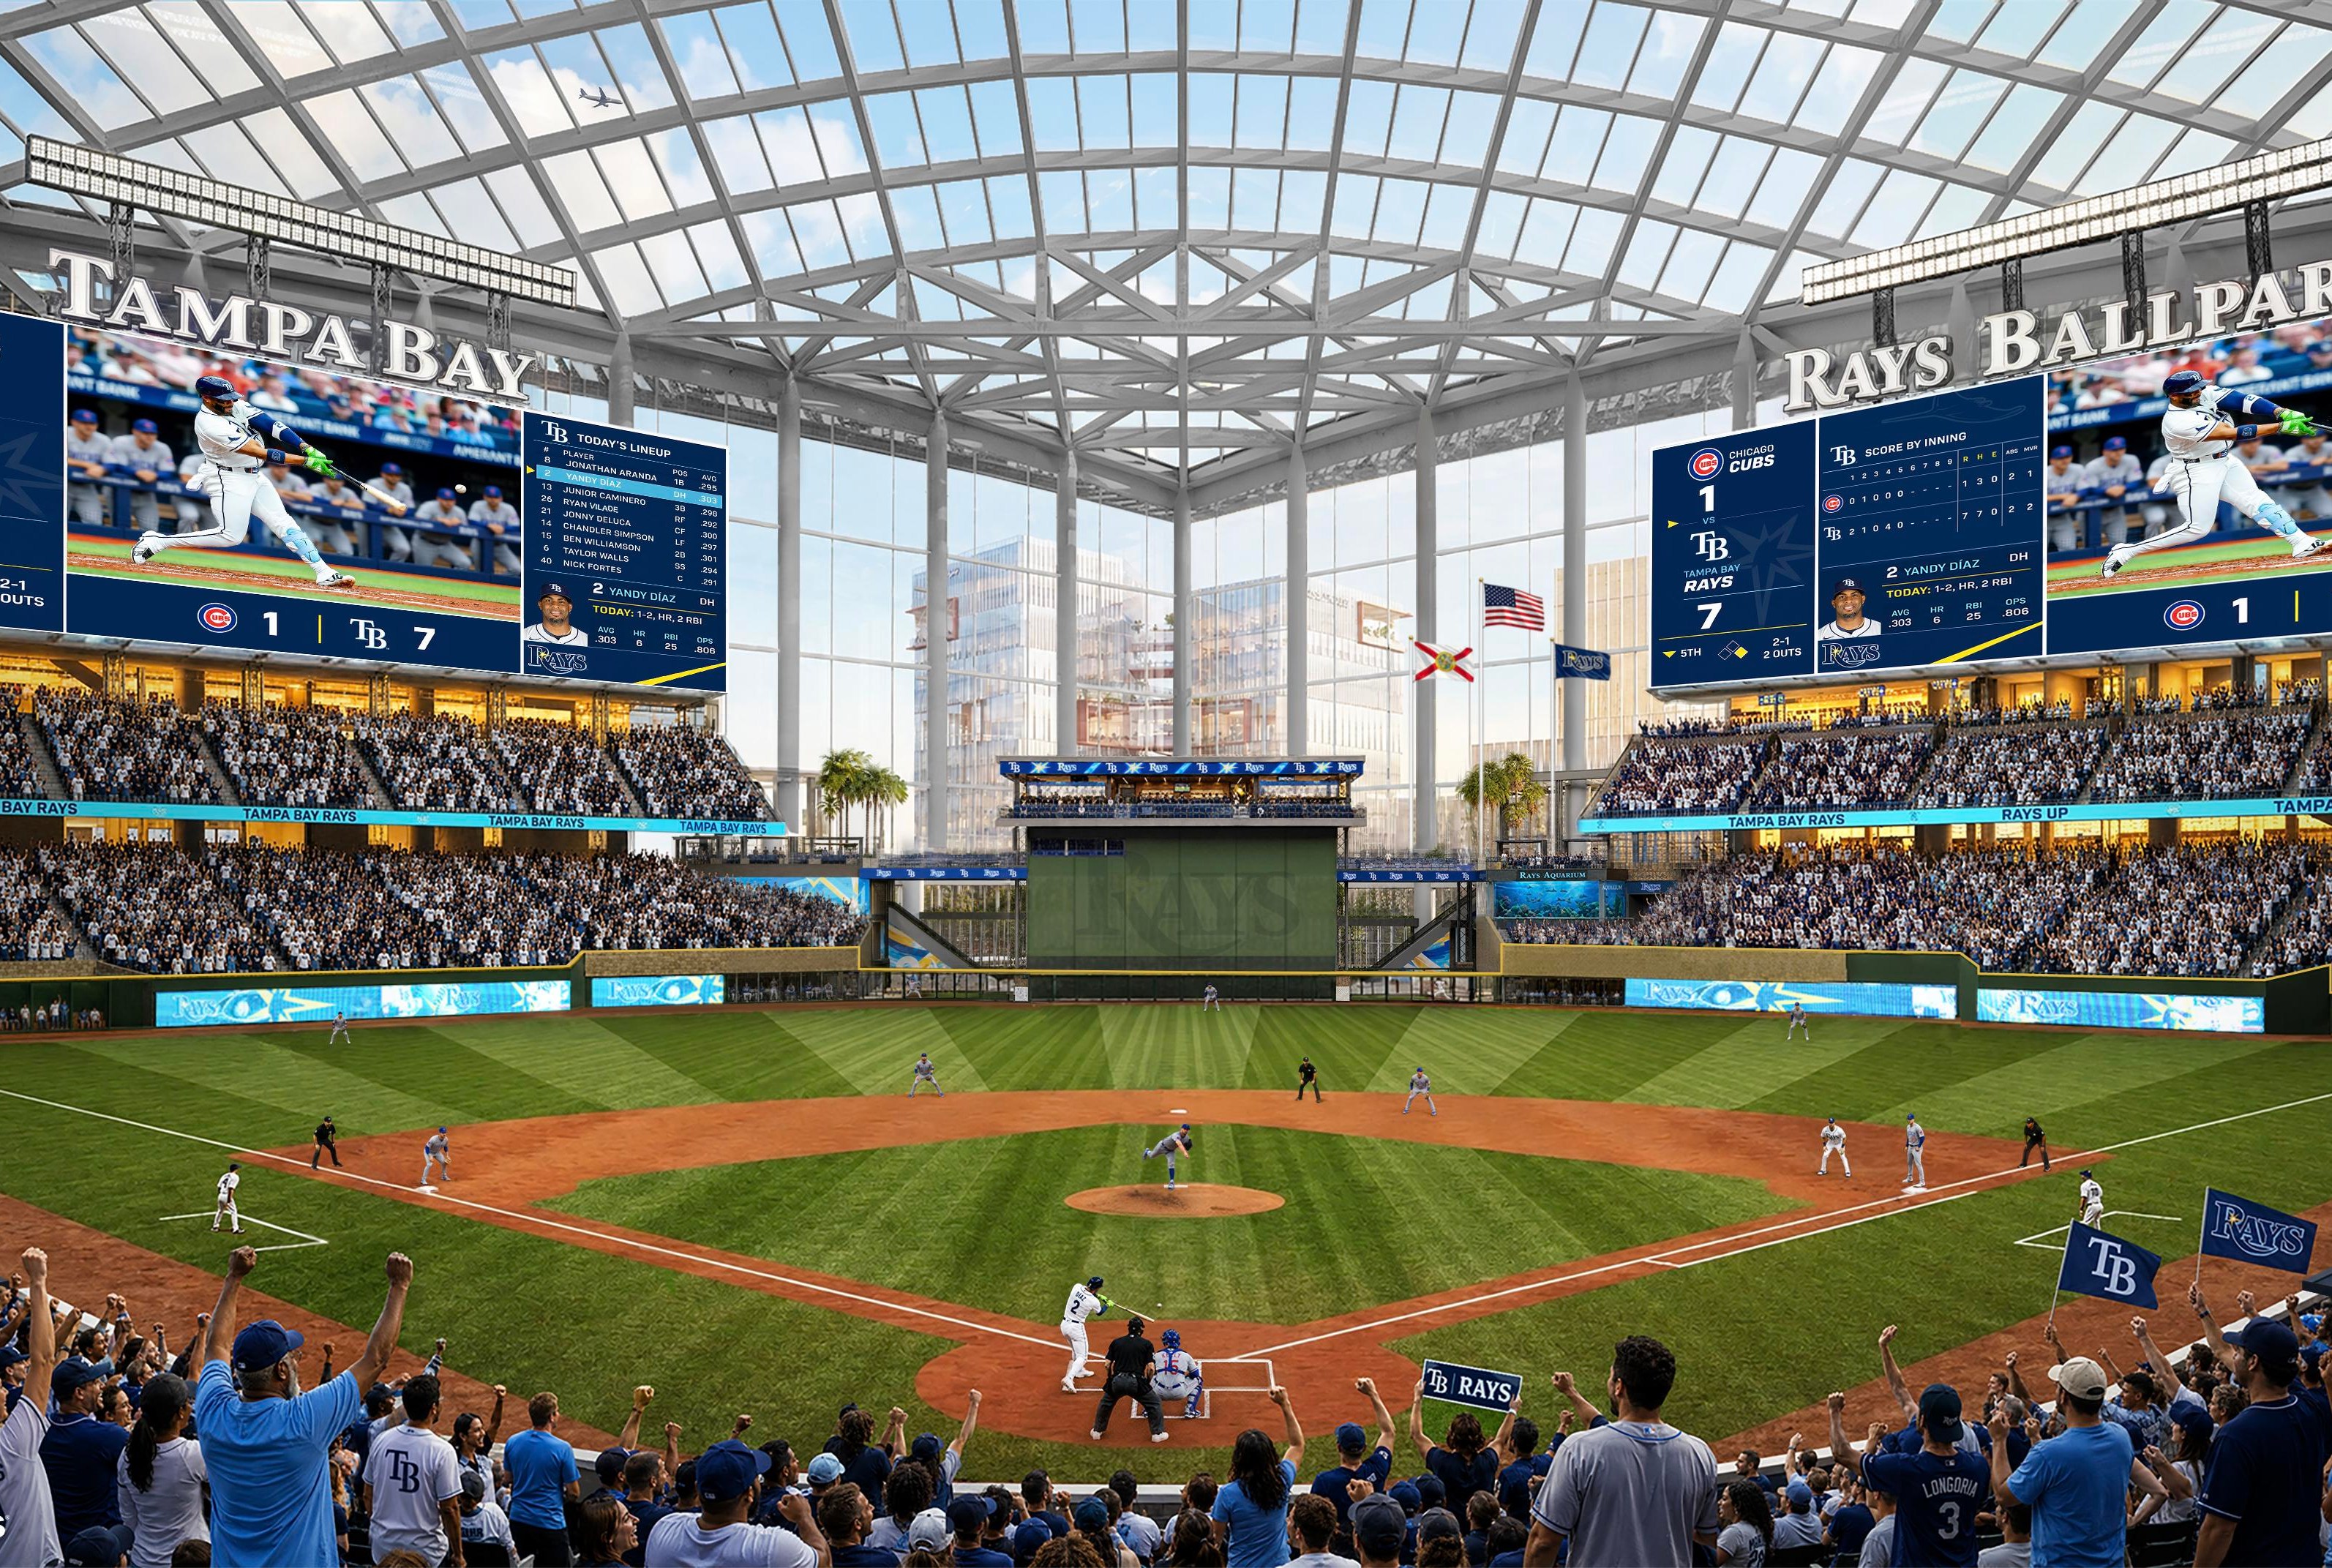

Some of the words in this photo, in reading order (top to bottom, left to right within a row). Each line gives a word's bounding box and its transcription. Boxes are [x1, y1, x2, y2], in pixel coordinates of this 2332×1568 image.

[49, 247, 367, 367] TAMPA
[383, 320, 534, 400] BAY
[1783, 336, 1954, 413] RAYS
[1984, 259, 2332, 376] BALLPAR
[541, 420, 568, 443] TB
[631, 443, 670, 457] LINEUP
[563, 450, 594, 460] PLAYER
[1730, 445, 1774, 459] CHICAGO
[1831, 446, 1856, 465] TB
[1865, 443, 1902, 457] SCORE
[1907, 440, 1922, 450] BY
[1924, 432, 1967, 447] INNING
[1730, 454, 1774, 473] CUBS
[566, 460, 617, 475] JONATHAN
[620, 470, 657, 481] ARANDA
[699, 484, 717, 492] .295
[563, 487, 597, 498] JUNIOR
[600, 492, 645, 506] CAMINERO
[566, 473, 597, 484] YANDY
[600, 479, 621, 488] DÍAZ
[698, 495, 717, 504] .303
[1699, 485, 1714, 511] 1
[563, 498, 587, 509] RYAN
[590, 503, 618, 513] VILADE
[700, 520, 717, 528] .292
[563, 510, 593, 521] JONNY
[596, 515, 631, 527] DELUCA
[1703, 517, 1715, 525] VS
[563, 522, 612, 536] CHANDLER
[615, 530, 654, 541] SIMPSON
[700, 543, 717, 551] .297
[563, 535, 581, 544] BEN
[584, 538, 640, 552] WILLIAMSON
[1690, 531, 1728, 561] TB
[563, 547, 597, 558] TAYLOR
[599, 552, 629, 562] WALLS
[563, 560, 585, 569] NICK
[588, 563, 621, 574] FORTES
[1684, 569, 1717, 578] TAMPA
[1721, 564, 1740, 574] BAY
[1886, 567, 1898, 578] 2
[1904, 563, 1946, 576] YANDY
[1950, 559, 1980, 571] DÍAZ
[2009, 552, 2028, 562] DH
[0, 578, 25, 590] 2-1
[1684, 576, 1733, 593] RAYS
[1886, 587, 1931, 598] TODAY:
[1934, 585, 1955, 593] 1-2,
[1959, 582, 1979, 590] HR,
[1992, 577, 2012, 586] RBI
[0, 593, 44, 606] OUTS
[593, 583, 603, 594] 2
[610, 587, 647, 599] YANDY
[650, 592, 675, 603] DÍAZ
[700, 598, 715, 606] DH
[593, 605, 634, 617] TODAY:
[637, 610, 656, 620] 1-2,
[659, 613, 675, 623] HR,
[1698, 603, 1722, 630] 7
[1892, 609, 1909, 617] AVG
[2006, 597, 2026, 605] OPS
[2232, 598, 2248, 623] 1
[1889, 618, 1911, 628] .303
[1966, 612, 1981, 620] 25
[2002, 608, 2029, 617] .806
[263, 612, 278, 636] 1
[350, 618, 387, 650] TB
[413, 627, 435, 650] 7
[595, 636, 616, 644] .303
[665, 642, 677, 650] 25
[694, 646, 716, 655] .806
[697, 637, 713, 645] OPS
[1773, 637, 1790, 646] 2-1
[528, 645, 588, 674] RAYS
[1562, 650, 1603, 672] RAYS
[1681, 648, 1701, 657] 5TH
[1773, 648, 1802, 658] OUTS
[1822, 643, 1880, 667] RAYS
[1008, 762, 1020, 773] TB
[1057, 763, 1077, 773] RAYS
[1106, 763, 1117, 773] TB
[1149, 763, 1168, 773] RAYS
[1196, 763, 1207, 773] TB
[1245, 763, 1264, 773] RAYS
[1294, 763, 1305, 773] TB
[1338, 762, 1357, 773] RAYS
[2, 801, 32, 813] BAY
[37, 802, 77, 814] RAYS
[243, 808, 290, 820] TAMPA
[293, 809, 319, 821] BAY
[323, 809, 356, 822] RAYS
[2002, 809, 2042, 820] RAYS
[2047, 807, 2068, 819] UP
[489, 816, 528, 828] TAMPA
[532, 817, 553, 828] BAY
[556, 817, 585, 828] RAYS
[681, 821, 717, 832] TAMPA
[721, 822, 740, 833] BAY
[743, 824, 766, 833] RAYS
[1728, 815, 1774, 828] TAMPA
[1778, 814, 1806, 826] BAY
[1810, 814, 1845, 825] RAYS
[1544, 871, 1586, 879] AQUARIUM
[2211, 1200, 2305, 1256] RAYS
[2088, 1236, 2136, 1296] TB
[1071, 1300, 1080, 1315] 2
[1427, 1368, 1447, 1393] TB
[1458, 1376, 1512, 1403] RAYS
[385, 1449, 419, 1493] TB
[1922, 1477, 1978, 1498] LONGORIA
[1938, 1501, 1960, 1539] 3
